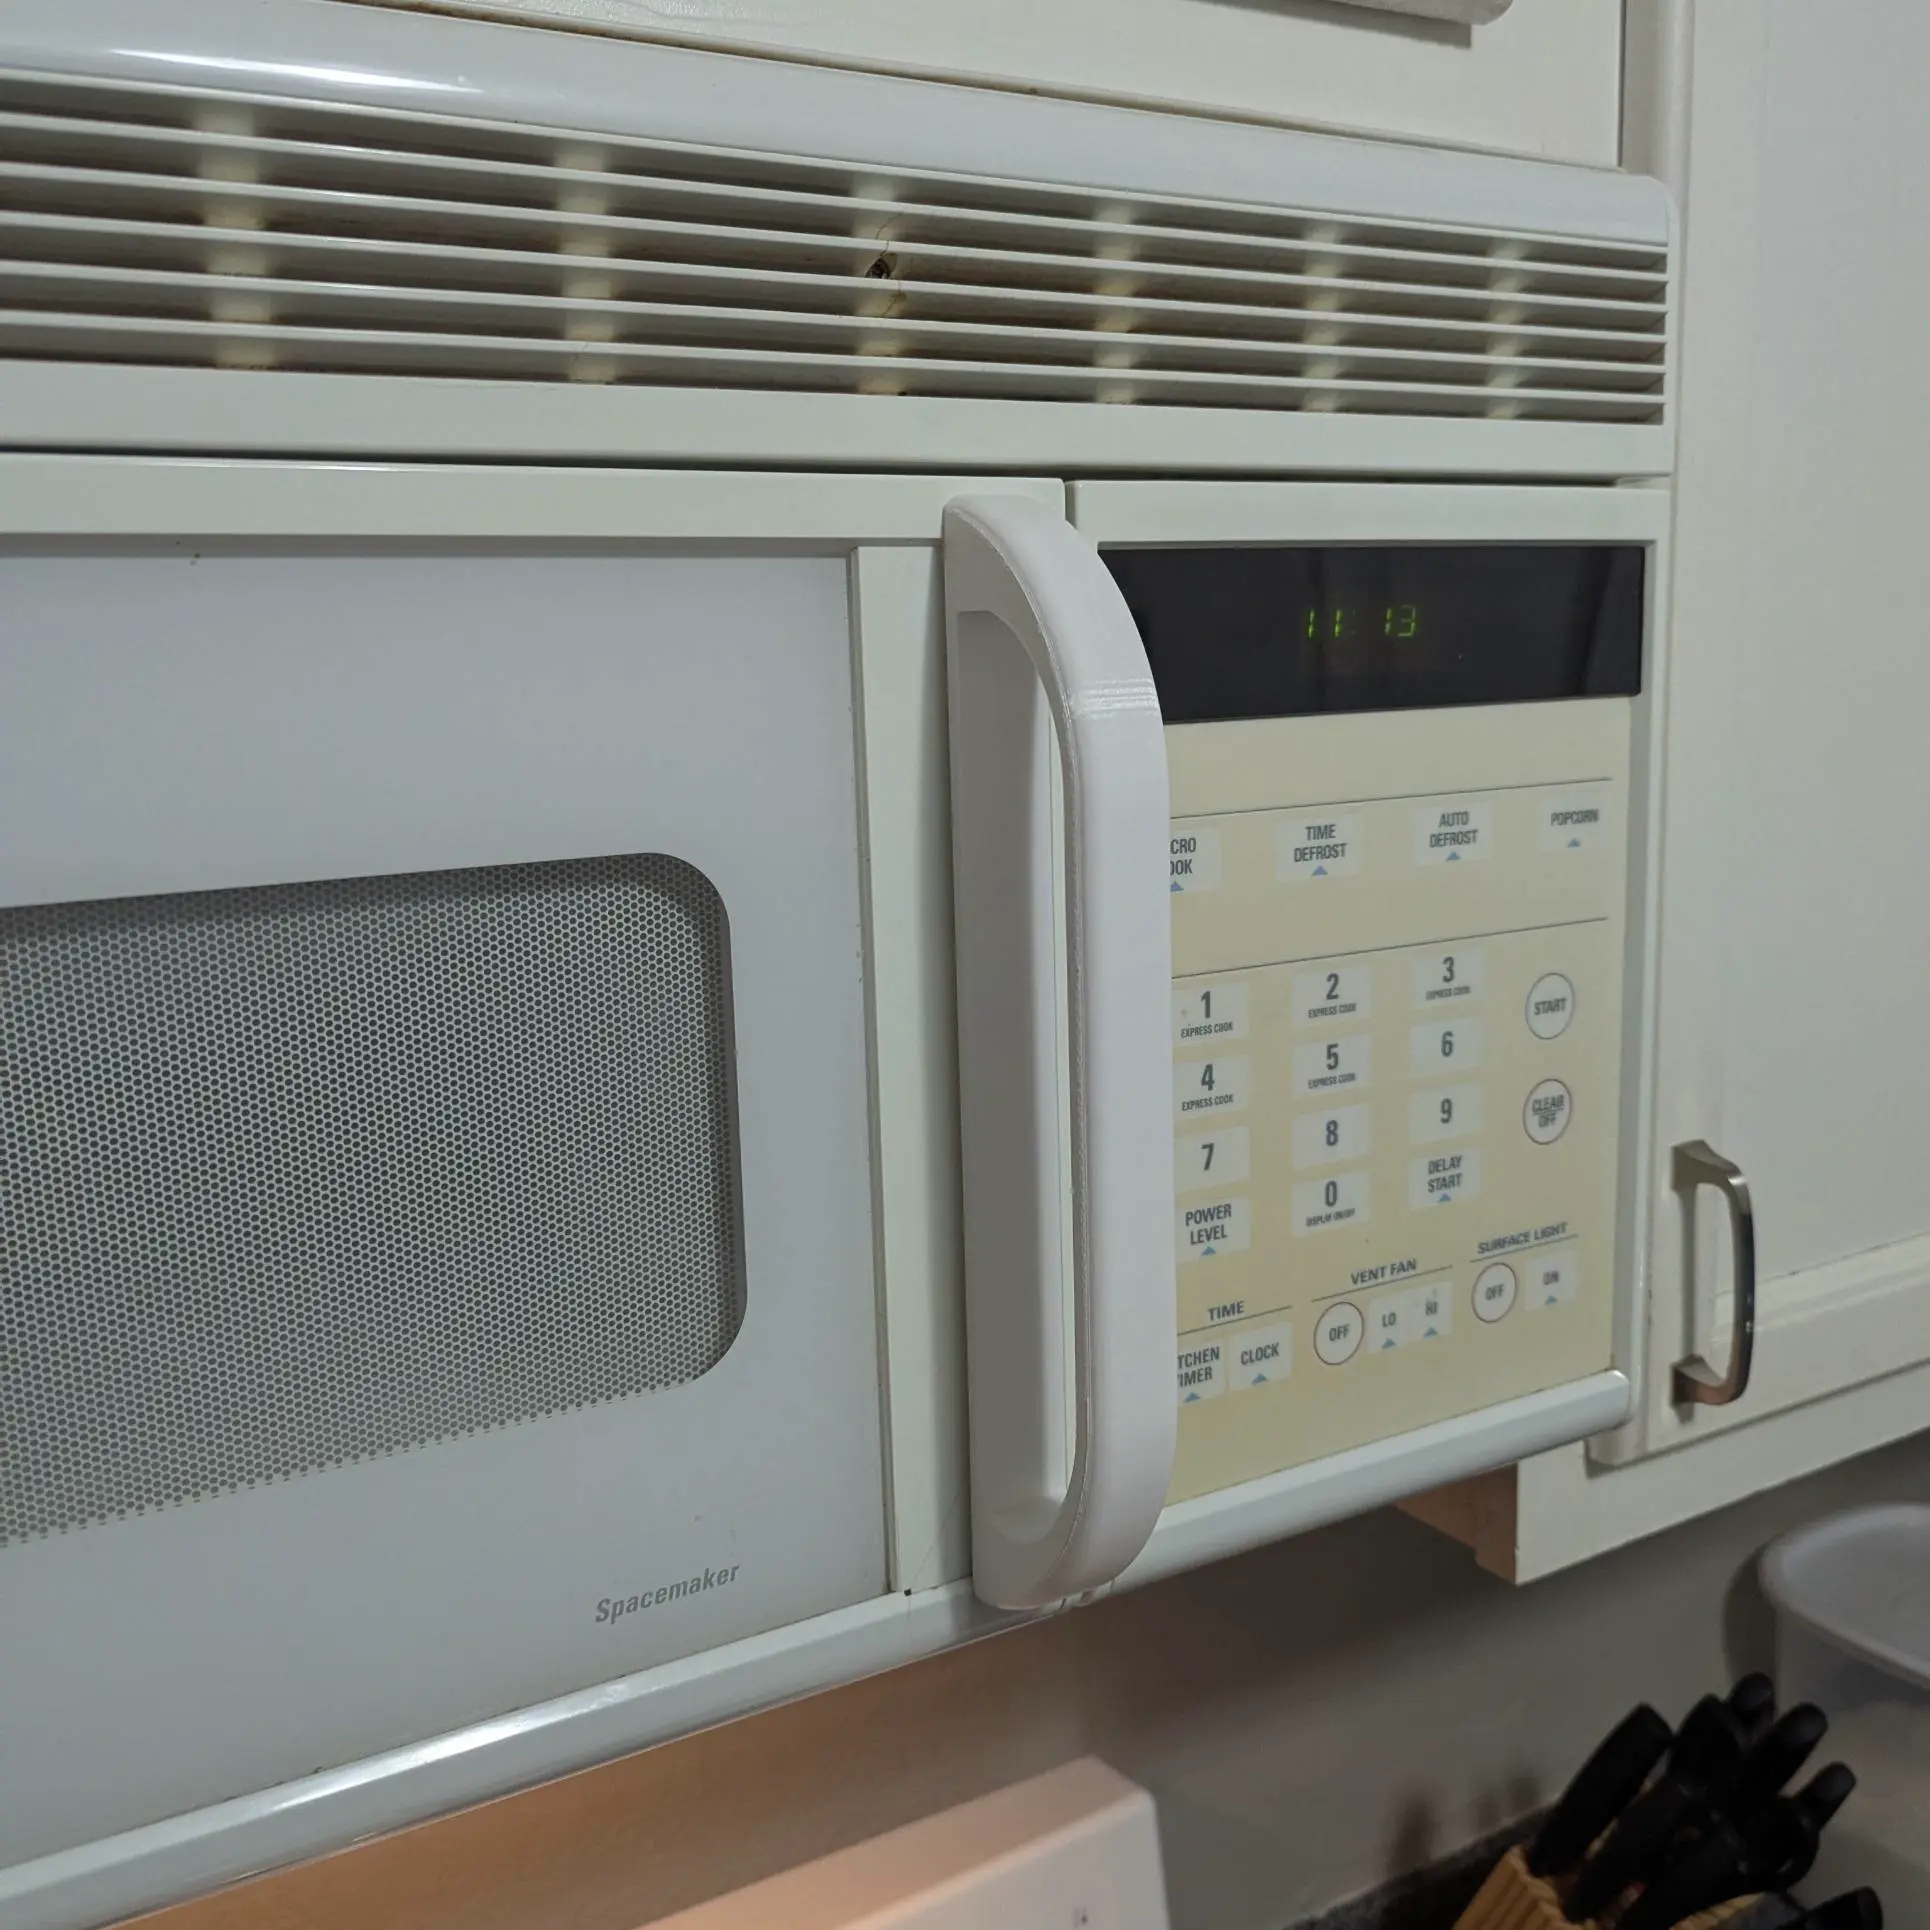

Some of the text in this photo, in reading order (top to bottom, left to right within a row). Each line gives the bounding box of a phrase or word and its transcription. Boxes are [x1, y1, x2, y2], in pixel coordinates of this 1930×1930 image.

[1439, 811, 1470, 828] AUTO
[1551, 809, 1599, 827] POPCORN
[1305, 824, 1337, 841] TIME
[1429, 829, 1478, 849] DEFROST
[1170, 837, 1197, 855] CRO
[1293, 843, 1348, 863] DEFROST
[1442, 956, 1455, 983] 3
[1326, 973, 1340, 1000] 2
[1200, 990, 1212, 1019] 1
[1308, 1003, 1357, 1019] EXPRESS COOK
[1533, 998, 1567, 1015] START
[1181, 1021, 1234, 1039] EXPRESS COOK
[1440, 1031, 1454, 1057] 6
[1326, 1043, 1339, 1070] 5
[1201, 1063, 1215, 1091] 4
[1181, 1094, 1234, 1112] EXPRESS COOK
[1440, 1098, 1453, 1124] 9
[1531, 1094, 1565, 1113] CLEAR
[1537, 1113, 1557, 1128] OFF
[1326, 1119, 1339, 1147] 8
[1200, 1143, 1215, 1171] 7
[1428, 1155, 1463, 1175] DELAY
[1427, 1173, 1463, 1193] START
[1324, 1180, 1338, 1207] 0
[1185, 1203, 1232, 1226] POWER
[1190, 1224, 1228, 1246] LEVEL
[1477, 1222, 1568, 1254] SURFACE LIGHT
[1350, 1258, 1417, 1285] VENT FAN
[1542, 1271, 1560, 1286] ON
[1485, 1284, 1505, 1301] OFF
[1207, 1301, 1245, 1321] TIME
[1425, 1301, 1438, 1317] HI
[1381, 1312, 1397, 1328] LO
[1328, 1323, 1350, 1342] OFF
[1177, 1346, 1220, 1369] TCHEN
[1240, 1342, 1280, 1366] CLOCK
[1177, 1366, 1213, 1387] IMER
[594, 1564, 740, 1625] Spacemaker
